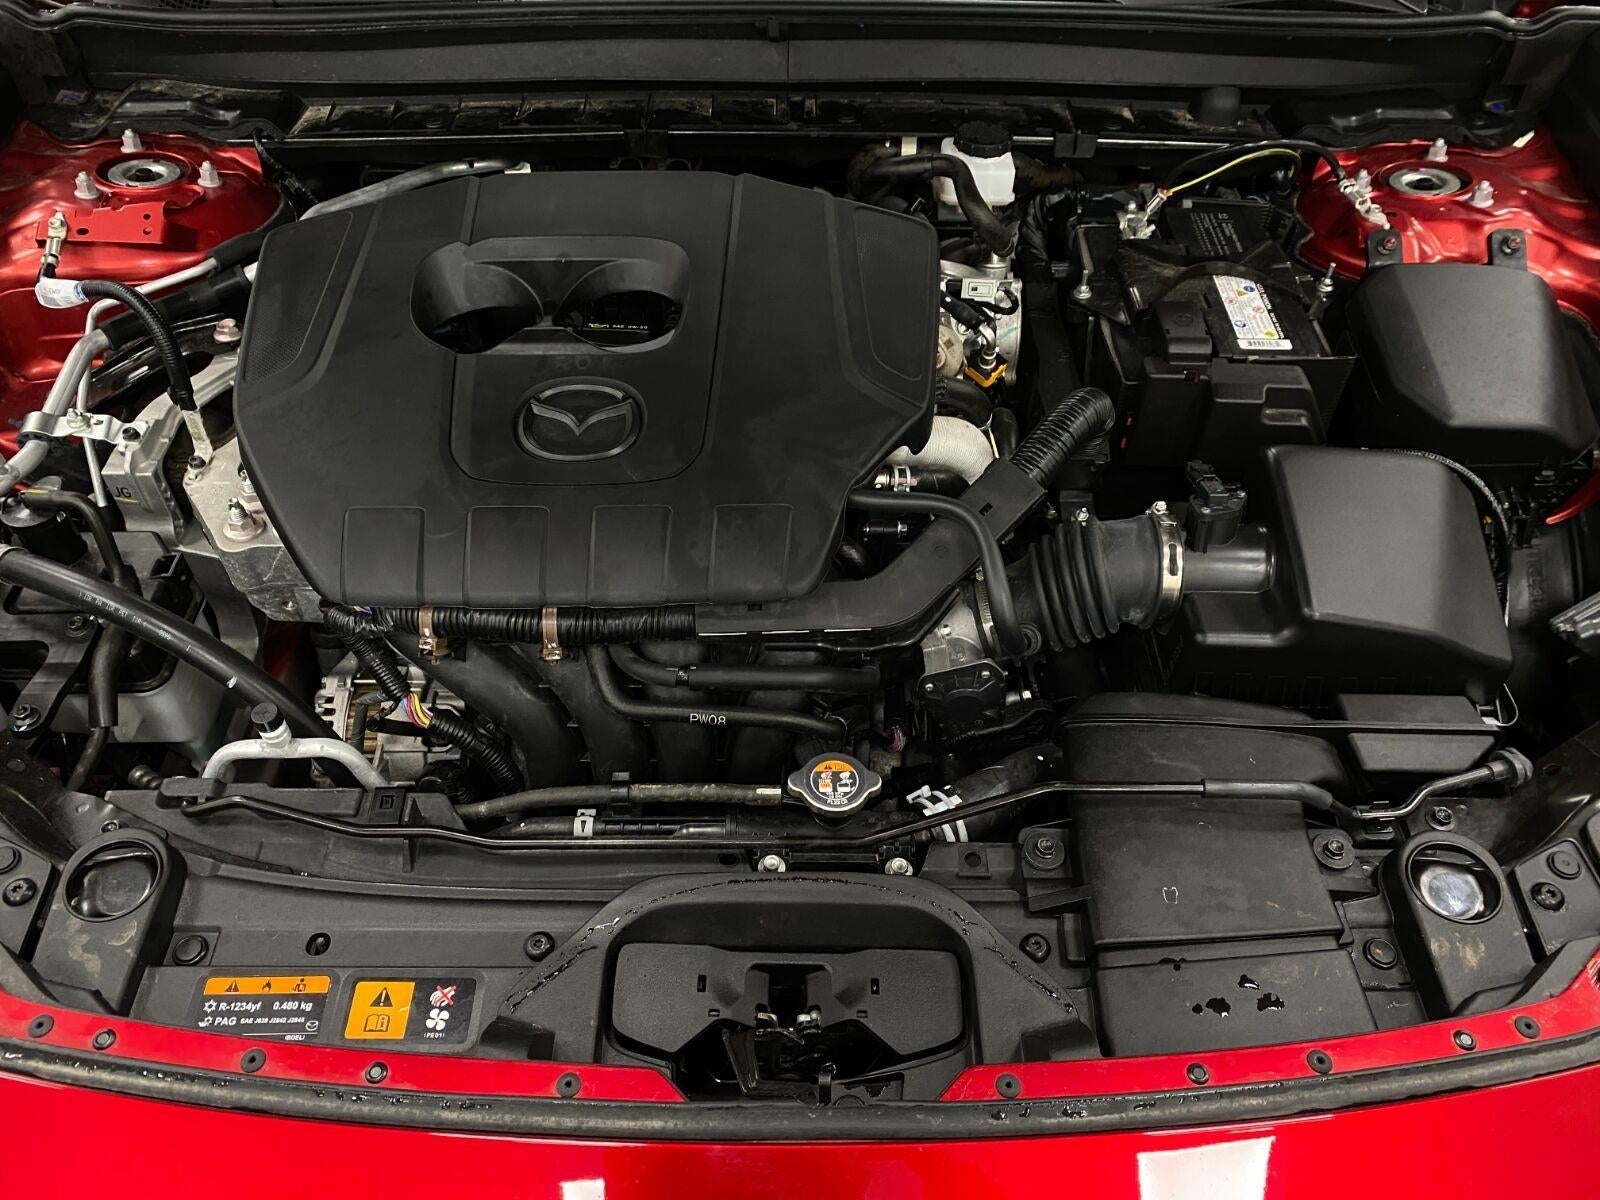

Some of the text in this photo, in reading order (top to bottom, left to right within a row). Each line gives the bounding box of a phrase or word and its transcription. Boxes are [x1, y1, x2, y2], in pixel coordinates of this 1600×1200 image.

[689, 713, 727, 726] PW08
[218, 1001, 262, 1012] R-1234yf
[300, 1001, 313, 1012] kg
[214, 1016, 237, 1026] PAG
